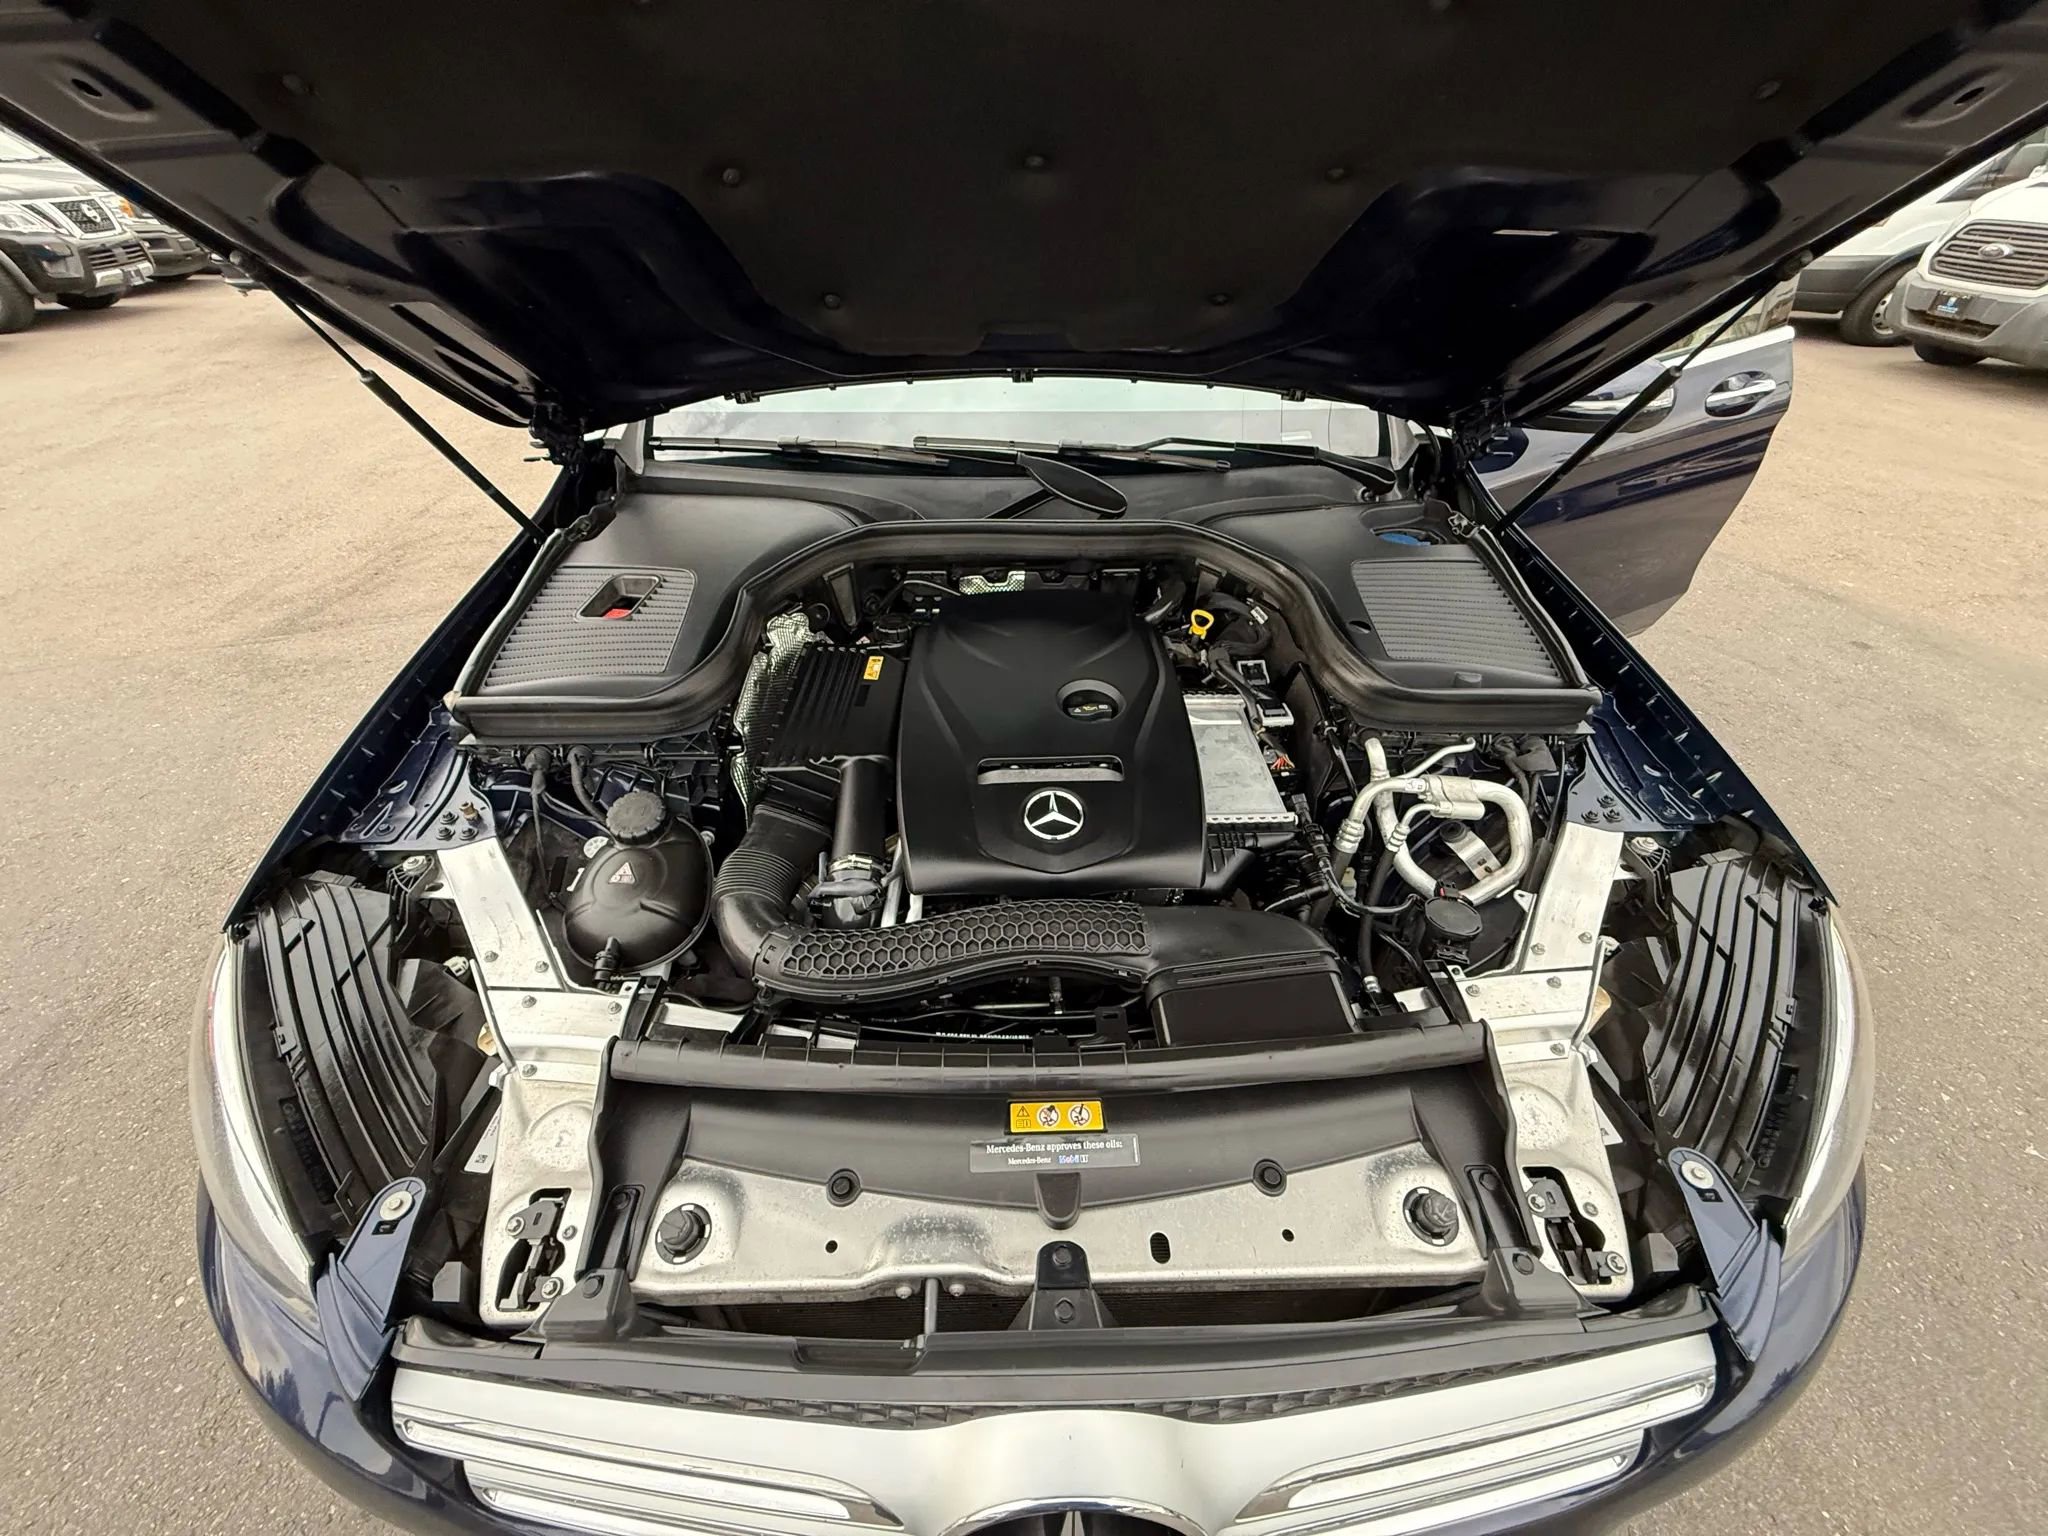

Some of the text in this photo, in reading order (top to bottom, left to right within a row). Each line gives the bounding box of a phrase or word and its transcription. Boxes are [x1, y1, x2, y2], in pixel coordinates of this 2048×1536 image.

[986, 1139, 1123, 1154] Mercedes-Benz approves these oils:
[1007, 1156, 1052, 1165] Mercedes-Benz
